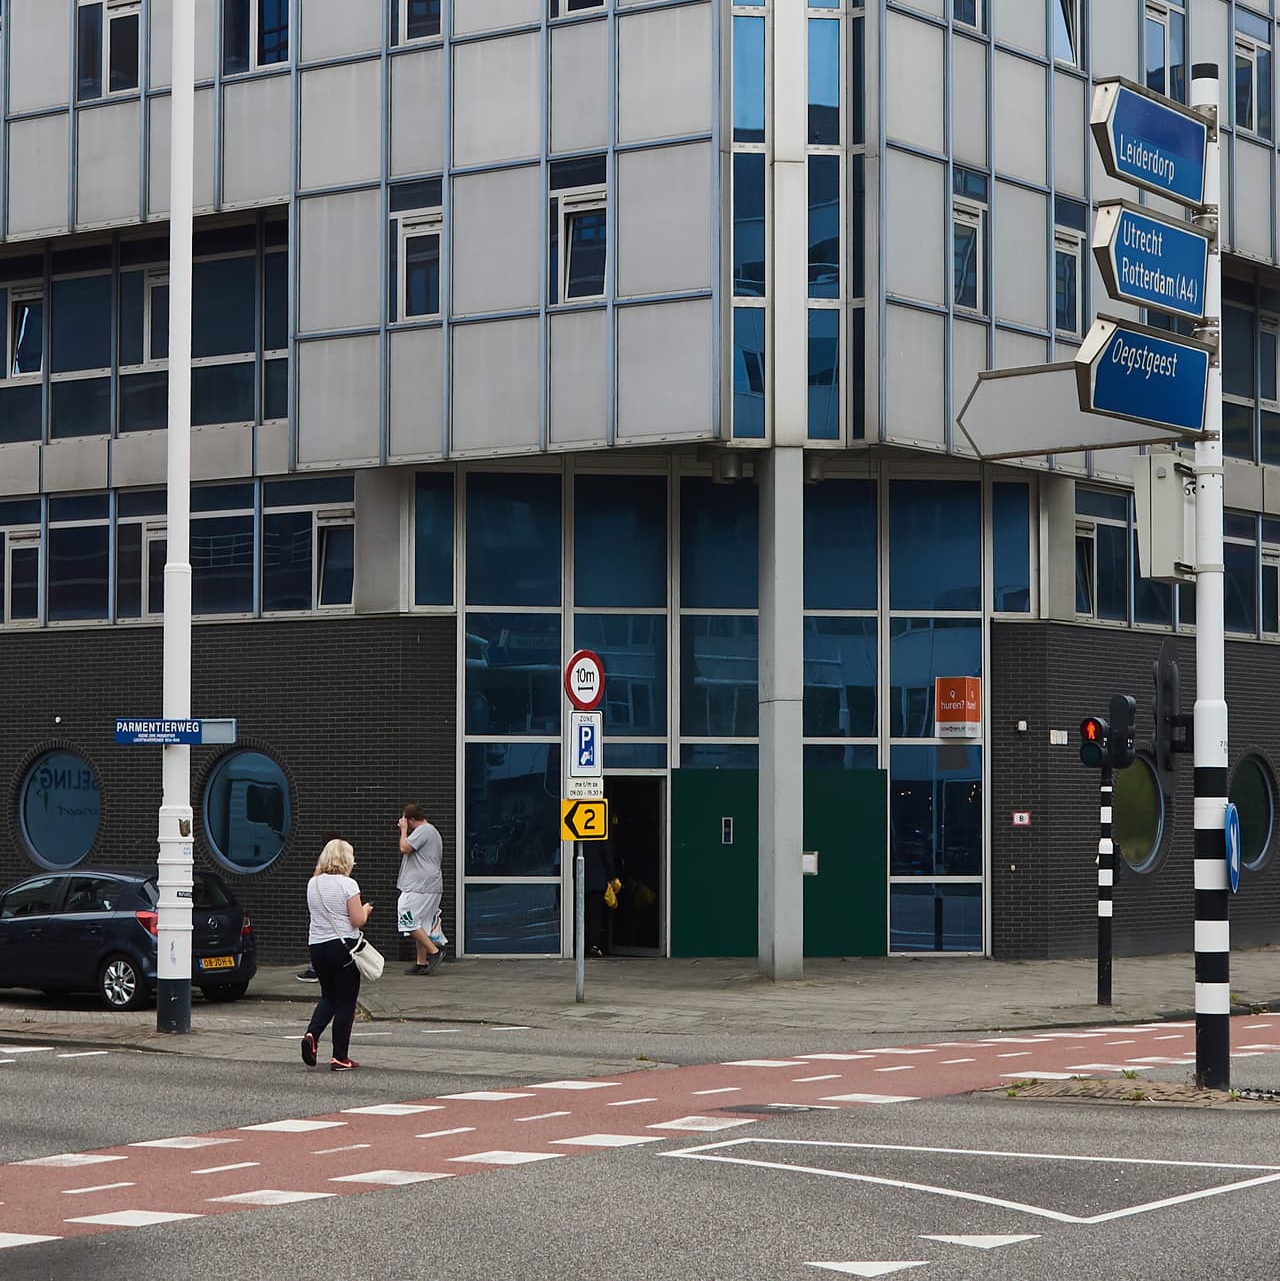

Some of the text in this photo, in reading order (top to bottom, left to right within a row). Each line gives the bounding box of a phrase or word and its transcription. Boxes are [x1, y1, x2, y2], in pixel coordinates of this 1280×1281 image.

[1120, 133, 1175, 185] Leiderdorp
[1123, 219, 1163, 257] Utrecht
[1122, 257, 1199, 305] Rotterdam (A4)
[1112, 338, 1178, 380] Oegstgeest
[576, 669, 595, 683] 10m
[940, 700, 965, 710] huren?
[116, 721, 200, 733] PARMENTIERWEG
[579, 715, 593, 723] ZONE
[581, 726, 592, 749] P
[584, 808, 596, 830] 2
